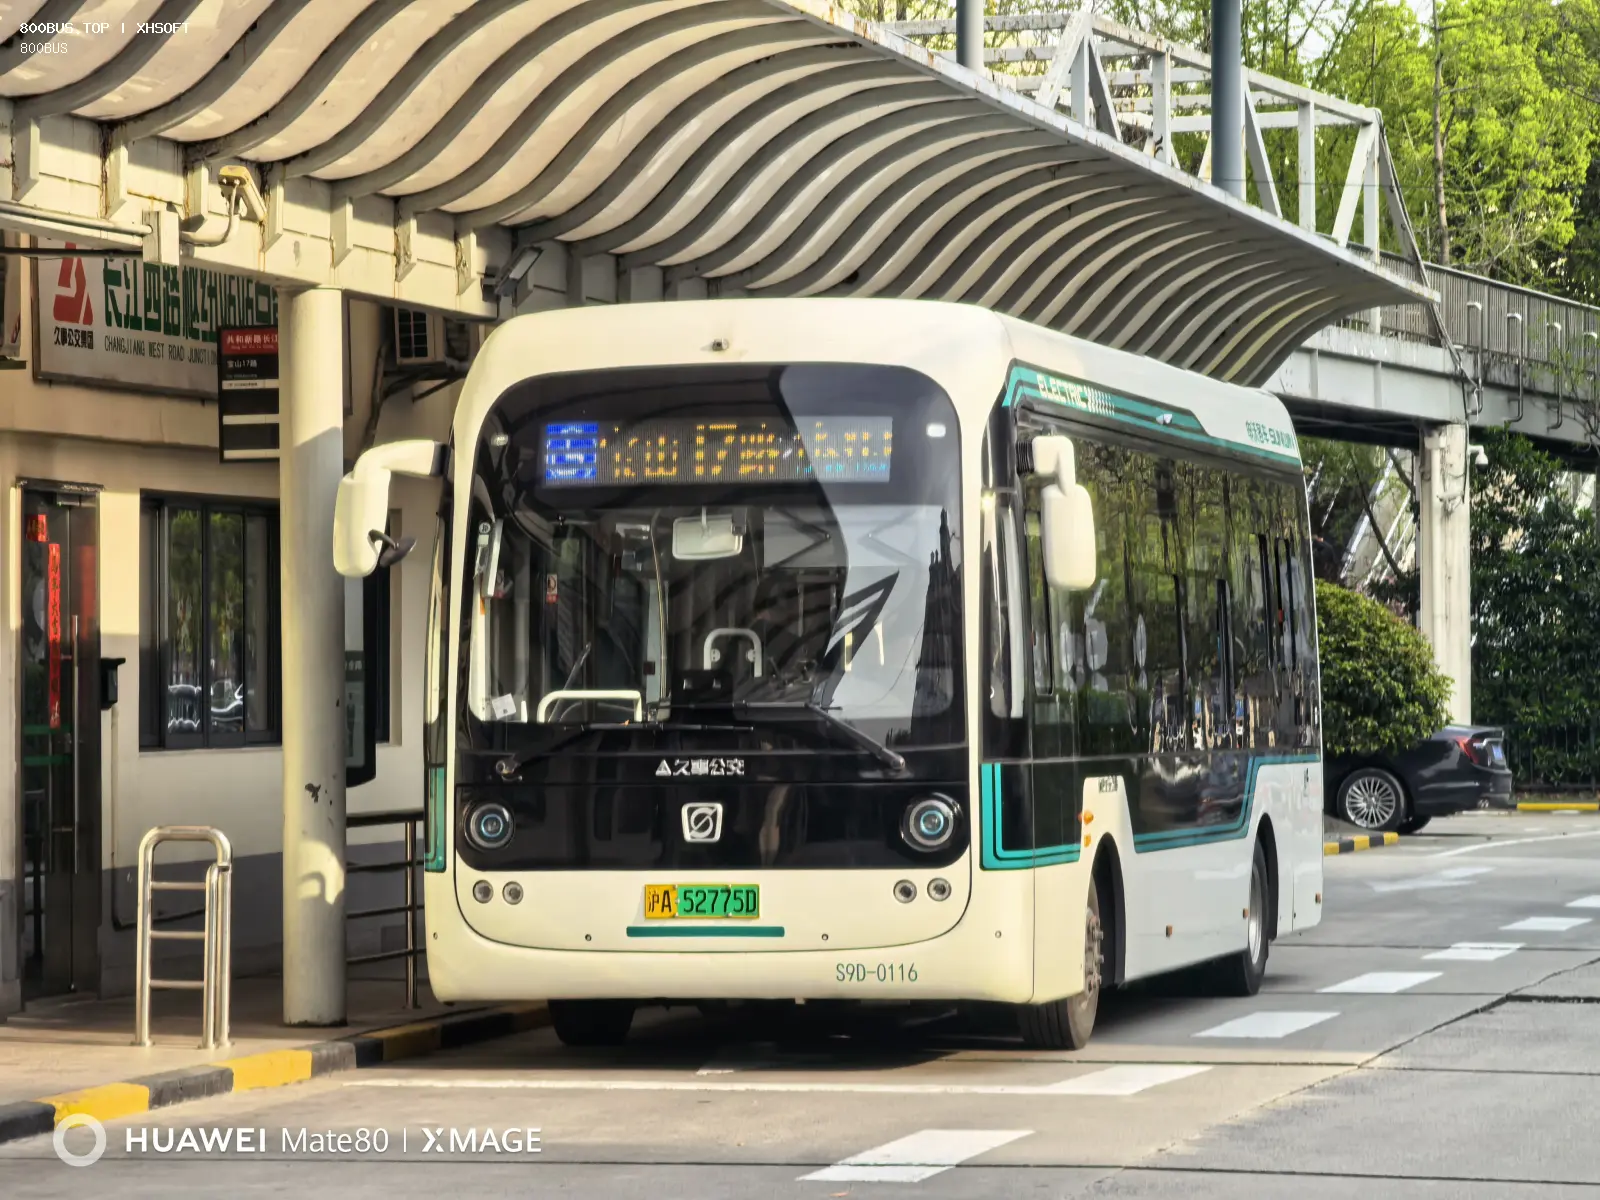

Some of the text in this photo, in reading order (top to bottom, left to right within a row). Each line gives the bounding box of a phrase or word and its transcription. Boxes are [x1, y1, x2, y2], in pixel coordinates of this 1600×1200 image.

[104, 335, 146, 357] CHANGJIANG
[148, 341, 165, 360] WEST
[168, 344, 185, 363] ROAD
[683, 889, 757, 914] 52775D
[836, 963, 918, 983] S9D-0116
